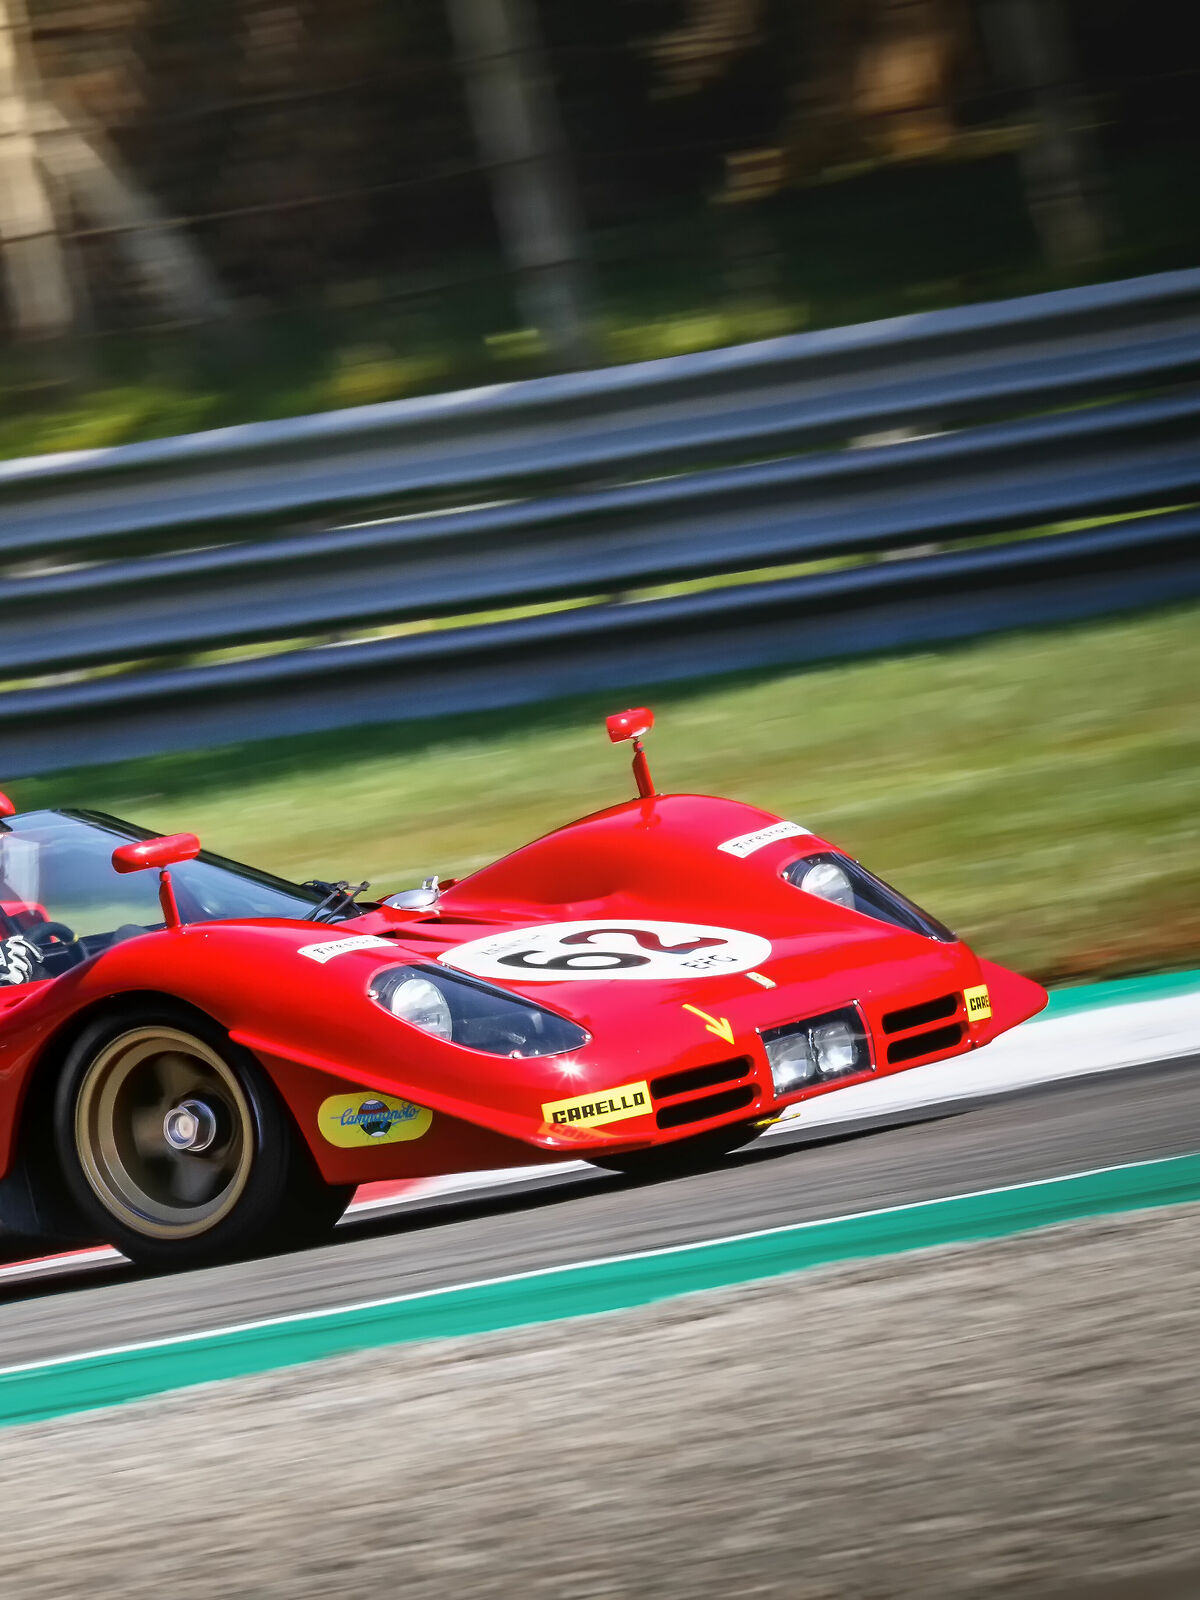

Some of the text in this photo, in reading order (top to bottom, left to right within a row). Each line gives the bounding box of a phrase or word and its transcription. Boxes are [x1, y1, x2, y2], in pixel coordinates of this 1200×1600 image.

[497, 928, 729, 970] 62
[330, 1102, 422, 1129] Campagnolo
[552, 1091, 646, 1124] CARELLO
